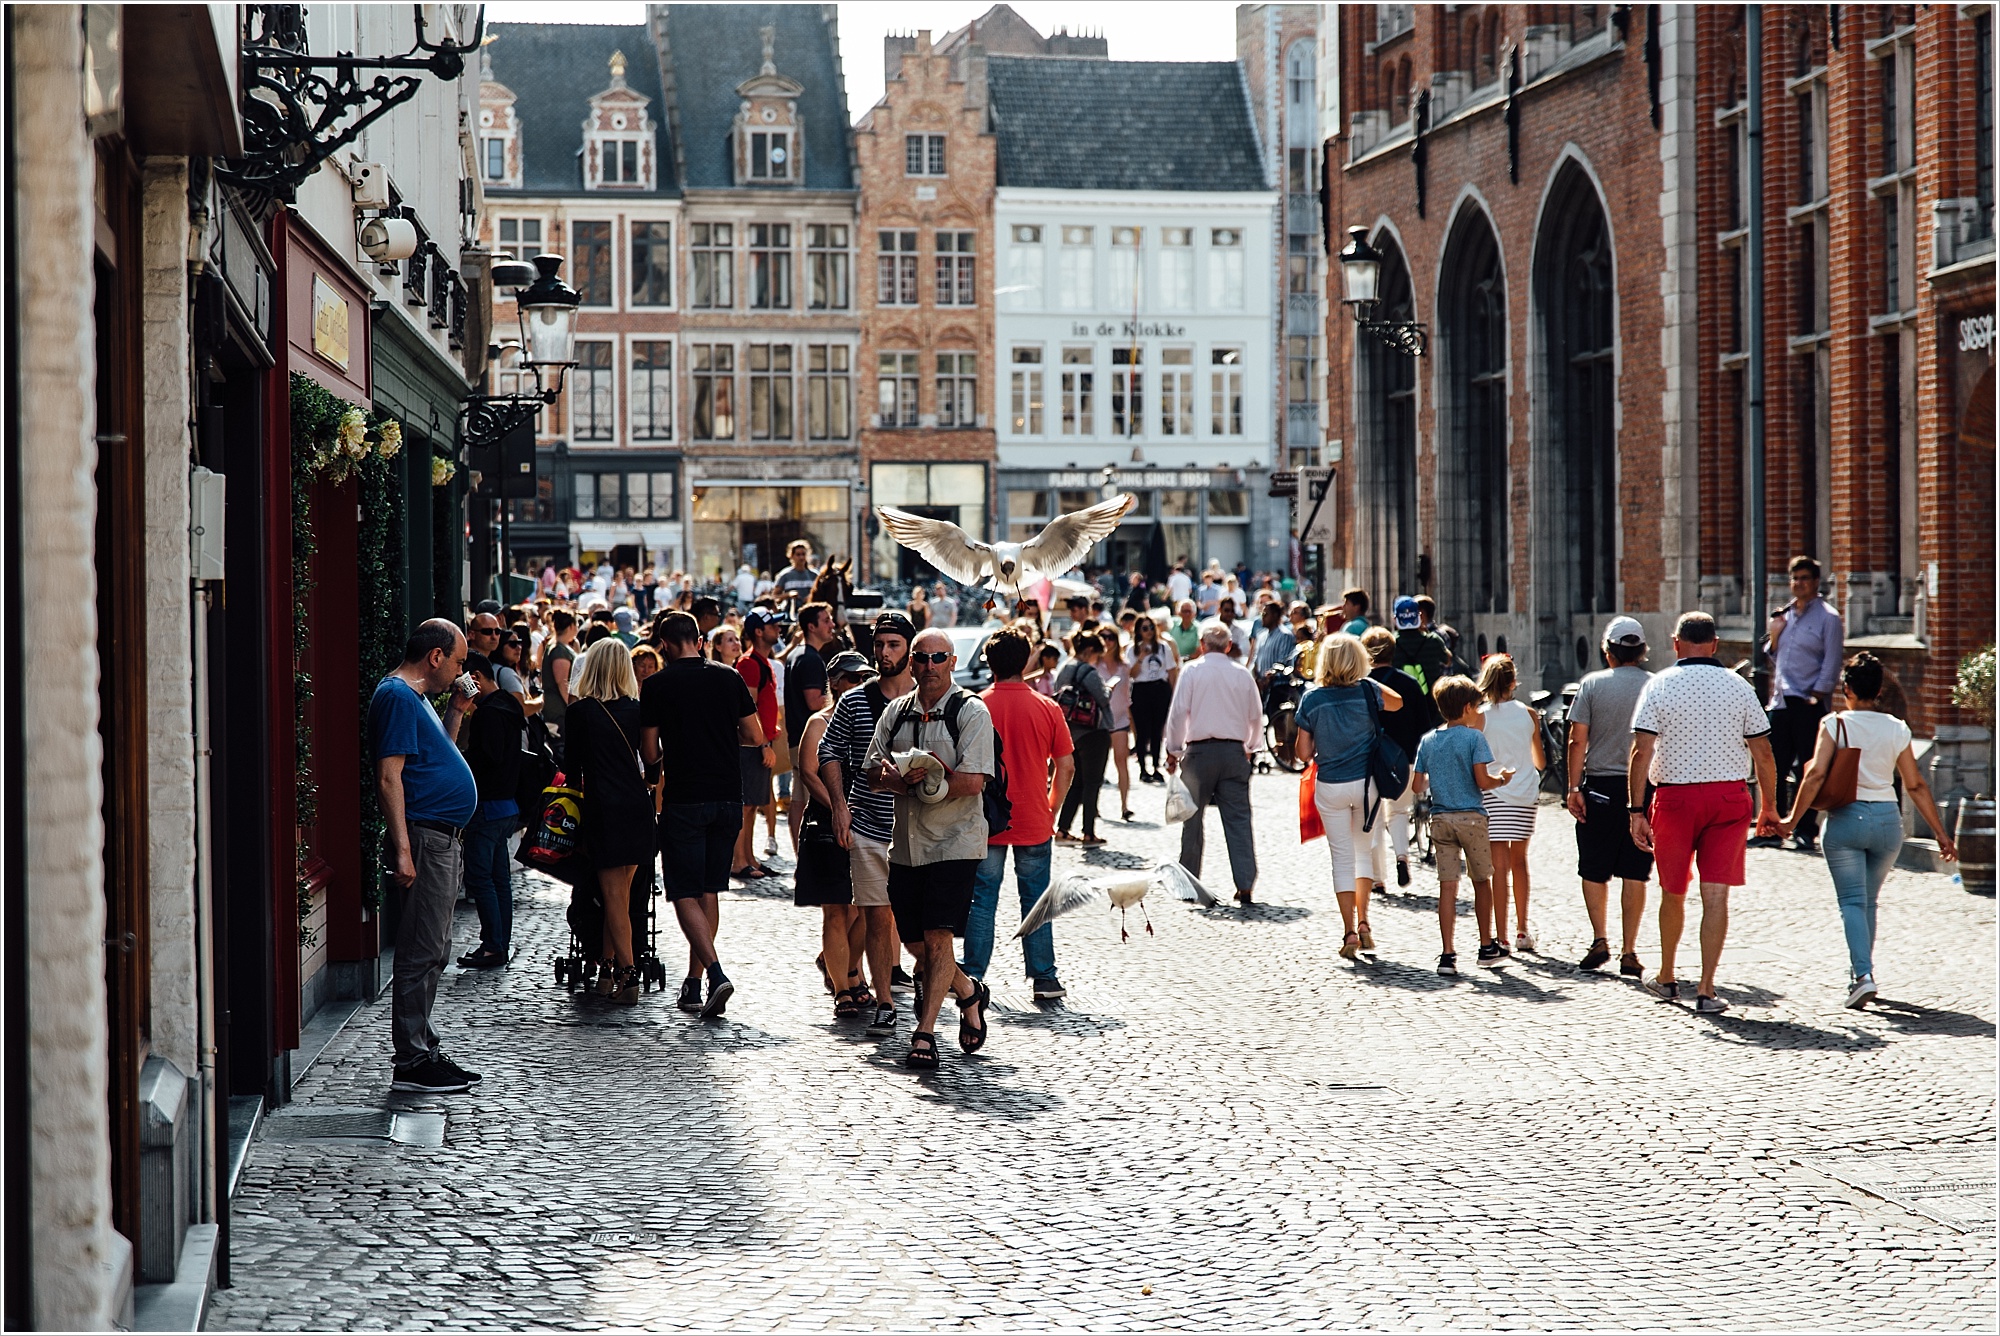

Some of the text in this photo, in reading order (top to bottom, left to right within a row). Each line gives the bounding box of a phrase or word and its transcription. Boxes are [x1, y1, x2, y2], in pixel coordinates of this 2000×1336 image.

[1072, 321, 1185, 337] in de Klokke
[1049, 472, 1087, 487] FLAME
[1144, 472, 1178, 487] SINCE
[1180, 472, 1210, 487] 1954
